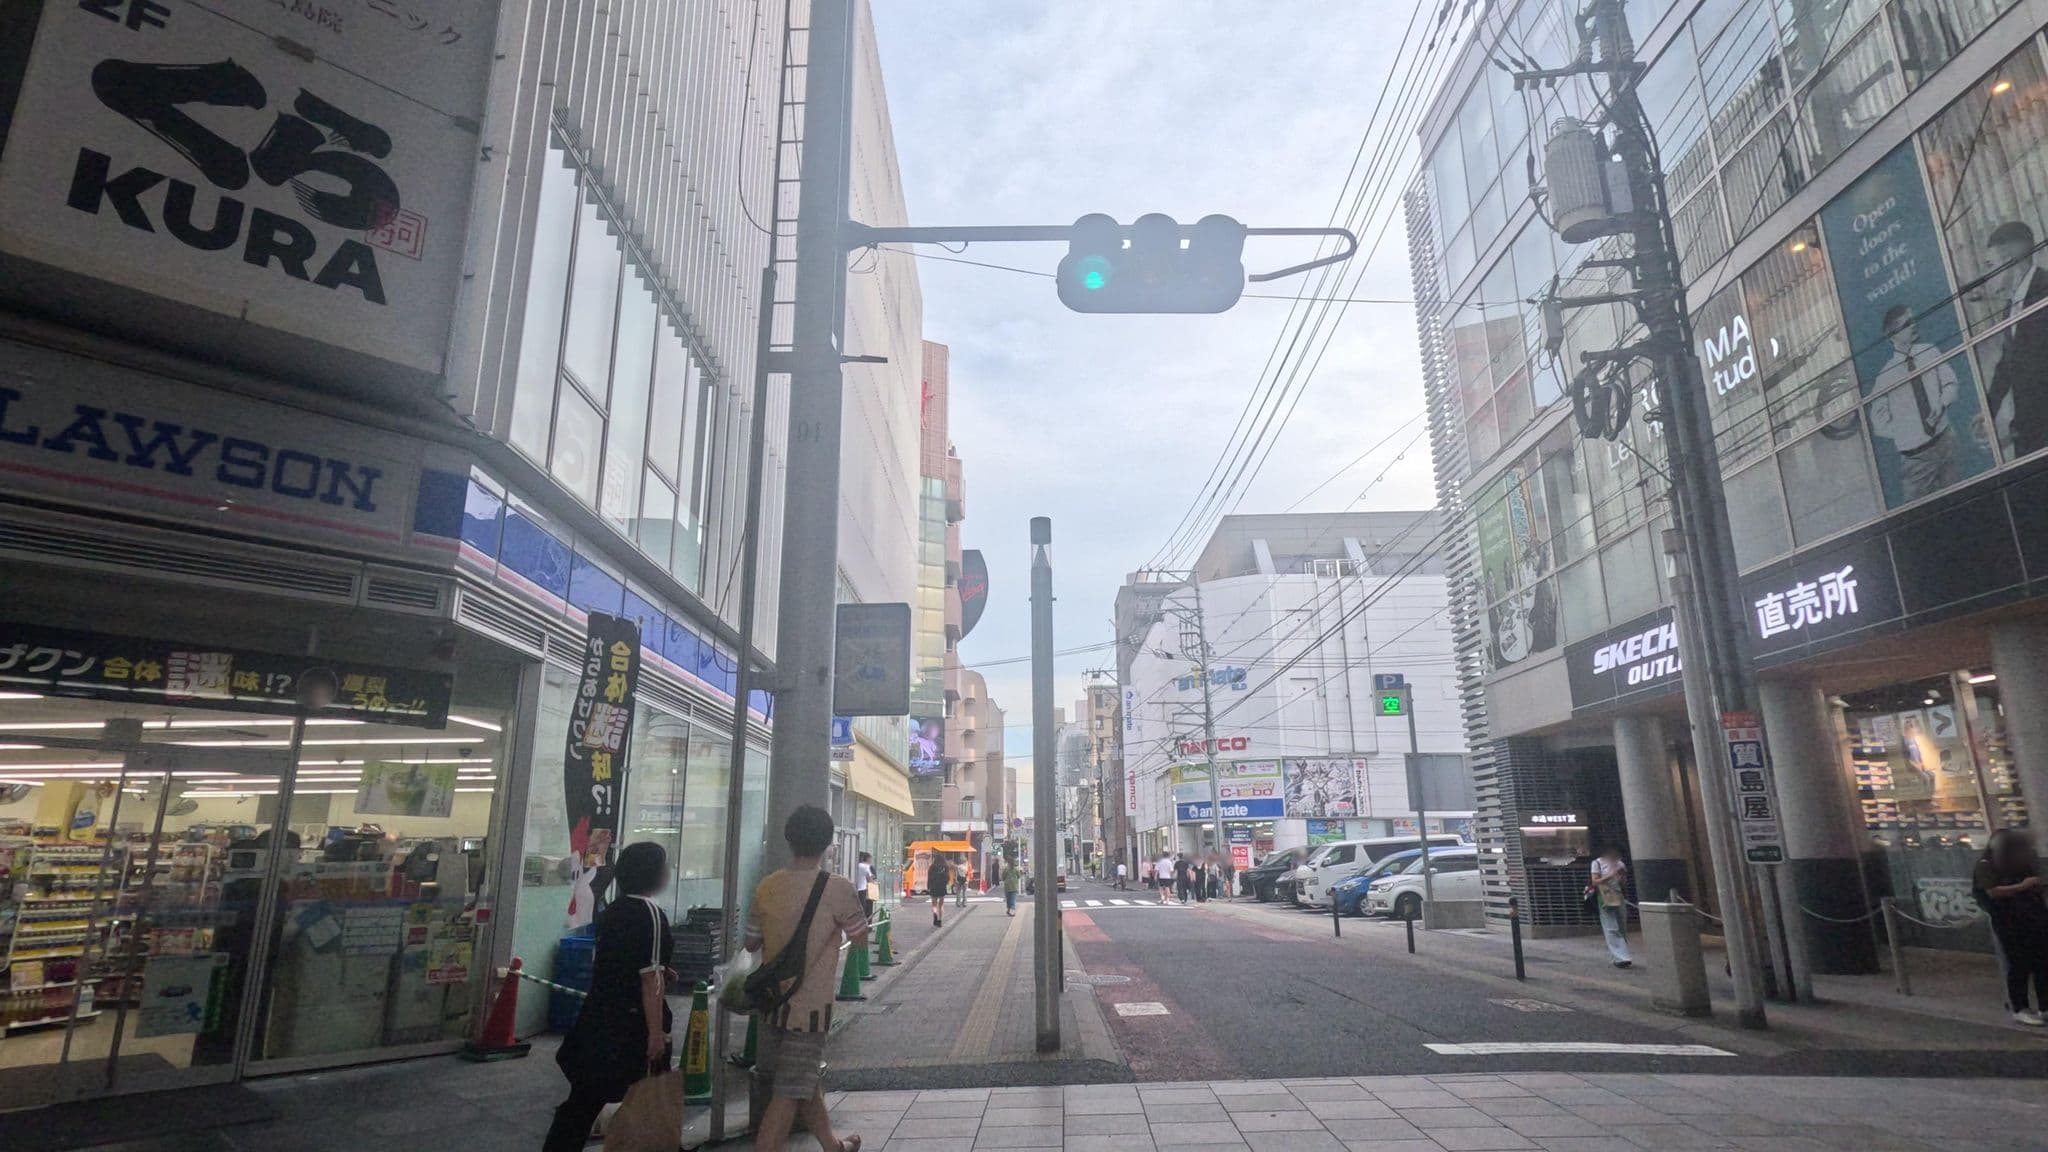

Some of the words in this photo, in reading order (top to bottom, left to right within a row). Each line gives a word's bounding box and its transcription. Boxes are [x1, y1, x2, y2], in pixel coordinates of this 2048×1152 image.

[91, 57, 401, 231] くら
[67, 147, 387, 306] KURA
[1853, 197, 1896, 232] Open
[1864, 262, 1880, 279] to
[1883, 242, 1908, 266] the
[1867, 259, 1917, 302] world!
[0, 387, 383, 513] LAWSON
[1755, 565, 1858, 638] 直売所
[1382, 675, 1397, 689] P
